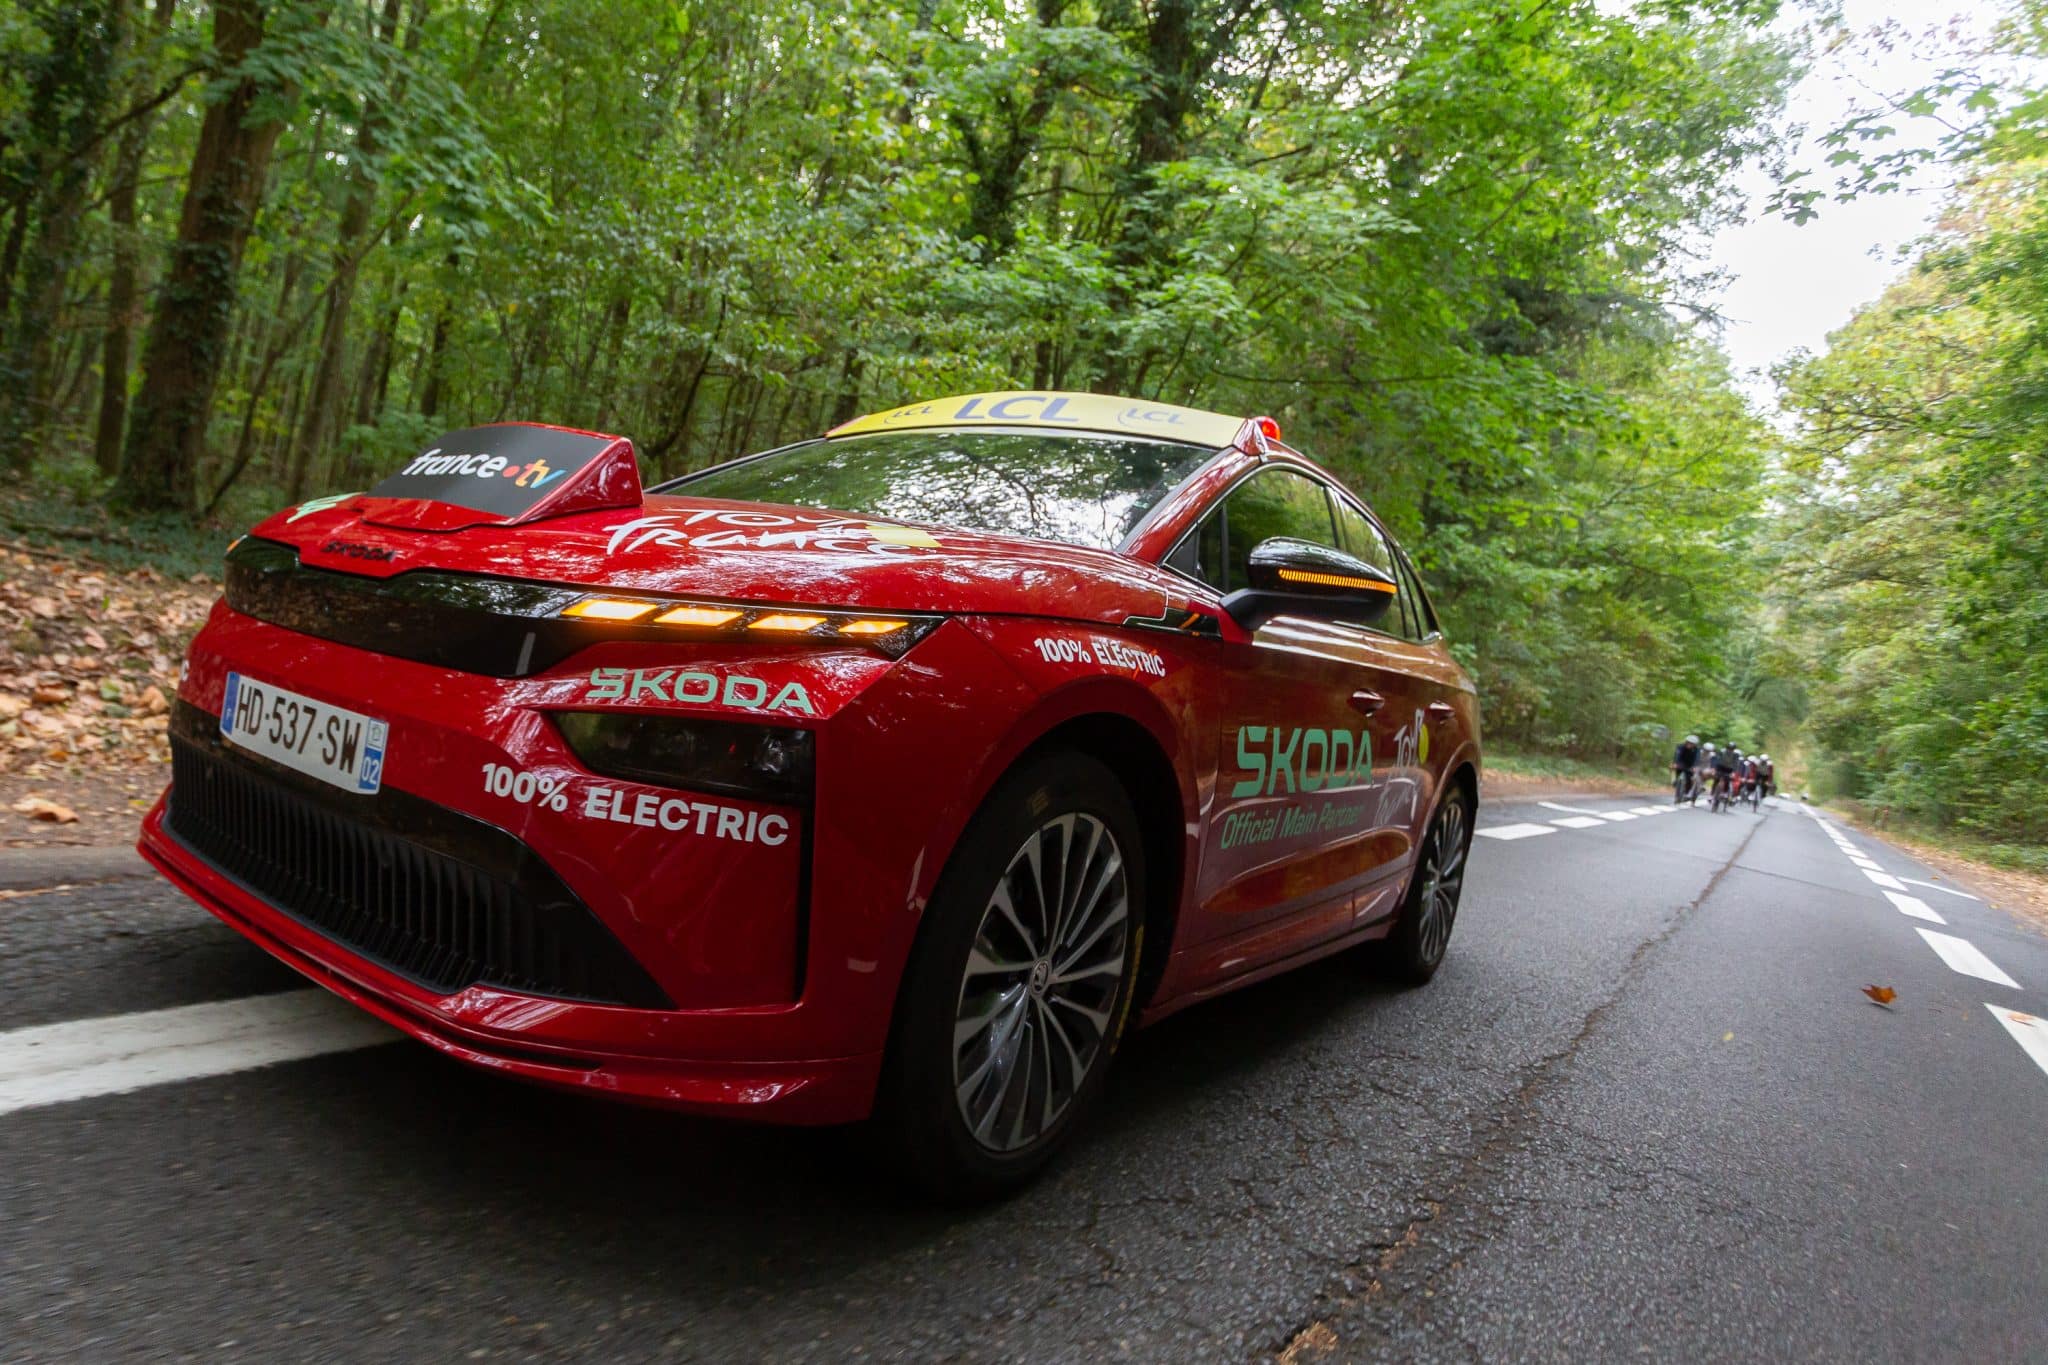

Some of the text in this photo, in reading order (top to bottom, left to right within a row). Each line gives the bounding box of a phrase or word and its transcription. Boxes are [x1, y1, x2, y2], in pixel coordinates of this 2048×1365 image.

[954, 396, 1079, 422] LCL
[1126, 407, 1184, 425] LCL
[1033, 637, 1166, 677] 100% ELECTRIC
[362, 757, 380, 785] 02
[482, 763, 789, 846] 100% ELECTRIC
[1220, 809, 1282, 849] Official
[1279, 803, 1319, 838] Main
